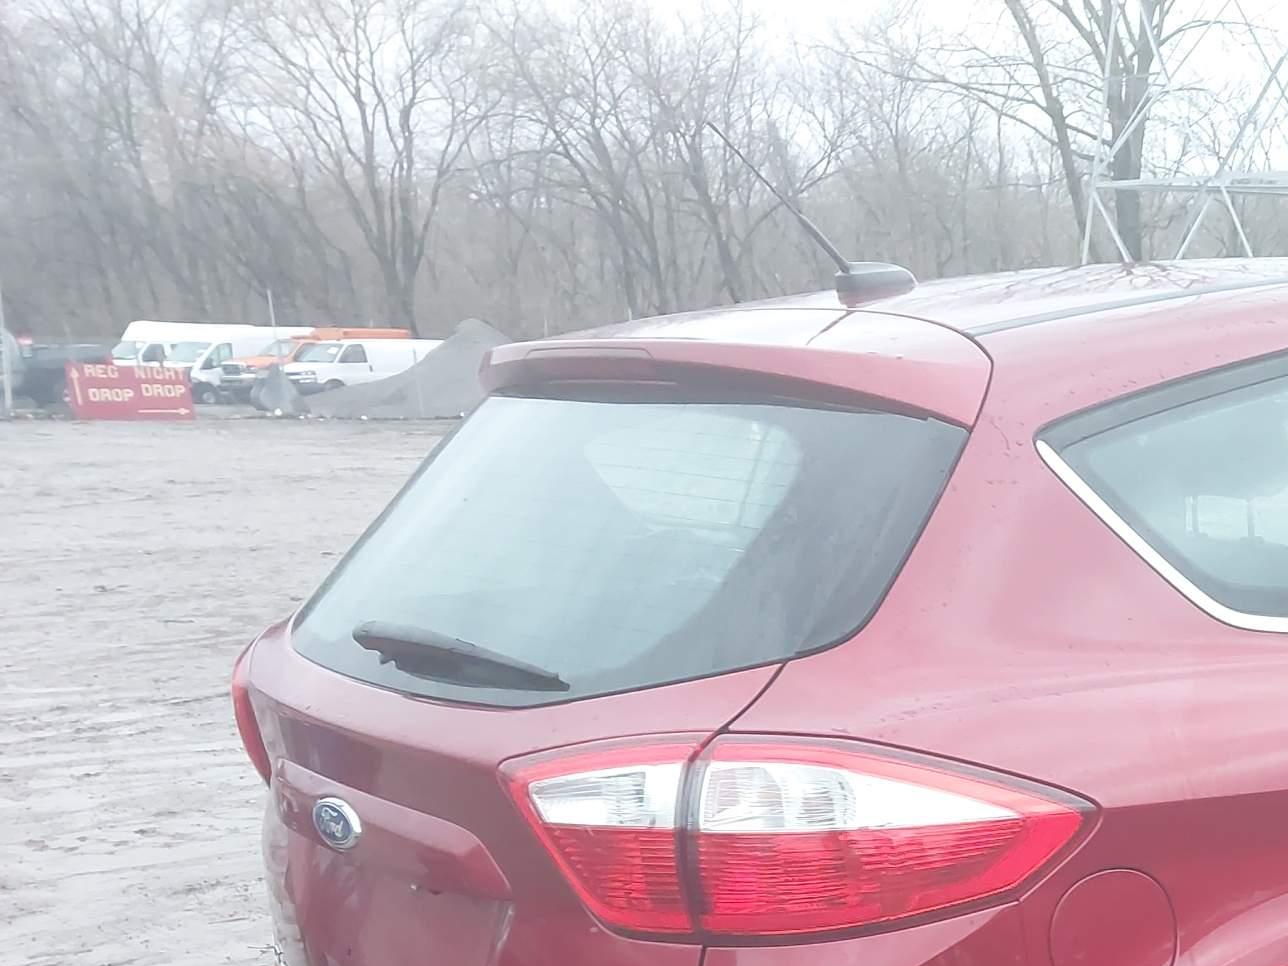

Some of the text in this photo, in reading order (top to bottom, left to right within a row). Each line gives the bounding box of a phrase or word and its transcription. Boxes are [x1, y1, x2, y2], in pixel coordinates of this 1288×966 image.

[133, 365, 186, 380] NIGHT
[88, 387, 134, 402] DROP
[140, 383, 186, 397] DROP
